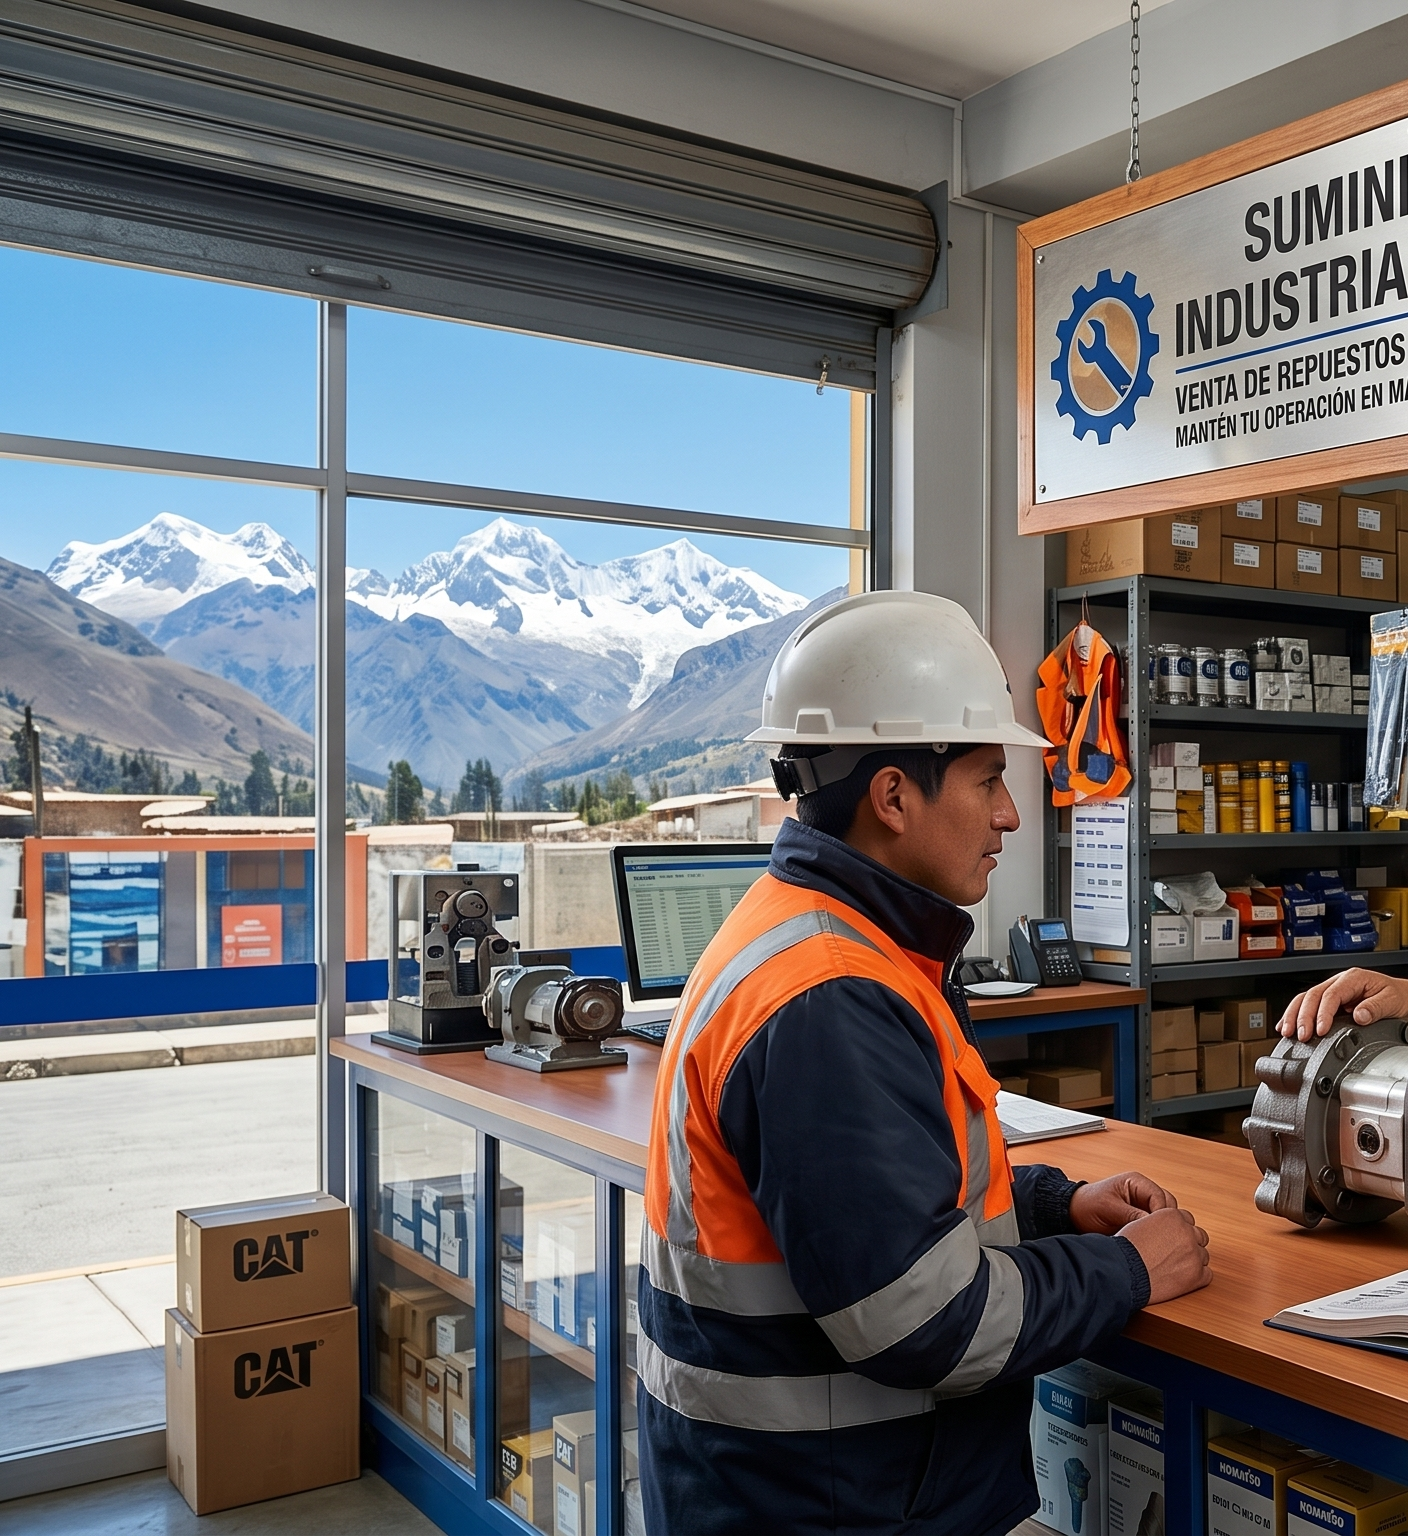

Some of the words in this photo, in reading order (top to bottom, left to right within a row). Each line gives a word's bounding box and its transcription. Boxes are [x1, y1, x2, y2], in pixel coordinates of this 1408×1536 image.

[1175, 372, 1239, 415] VENTA
[1244, 364, 1271, 400] DE
[1277, 333, 1406, 392] REPUESTOS
[1175, 412, 1237, 448] MANTÉN
[1240, 410, 1260, 435] TU
[1264, 387, 1356, 430] OPERACIÓN
[1361, 382, 1384, 410] EN
[233, 1230, 309, 1282] CAT
[234, 1340, 317, 1399] CAT
